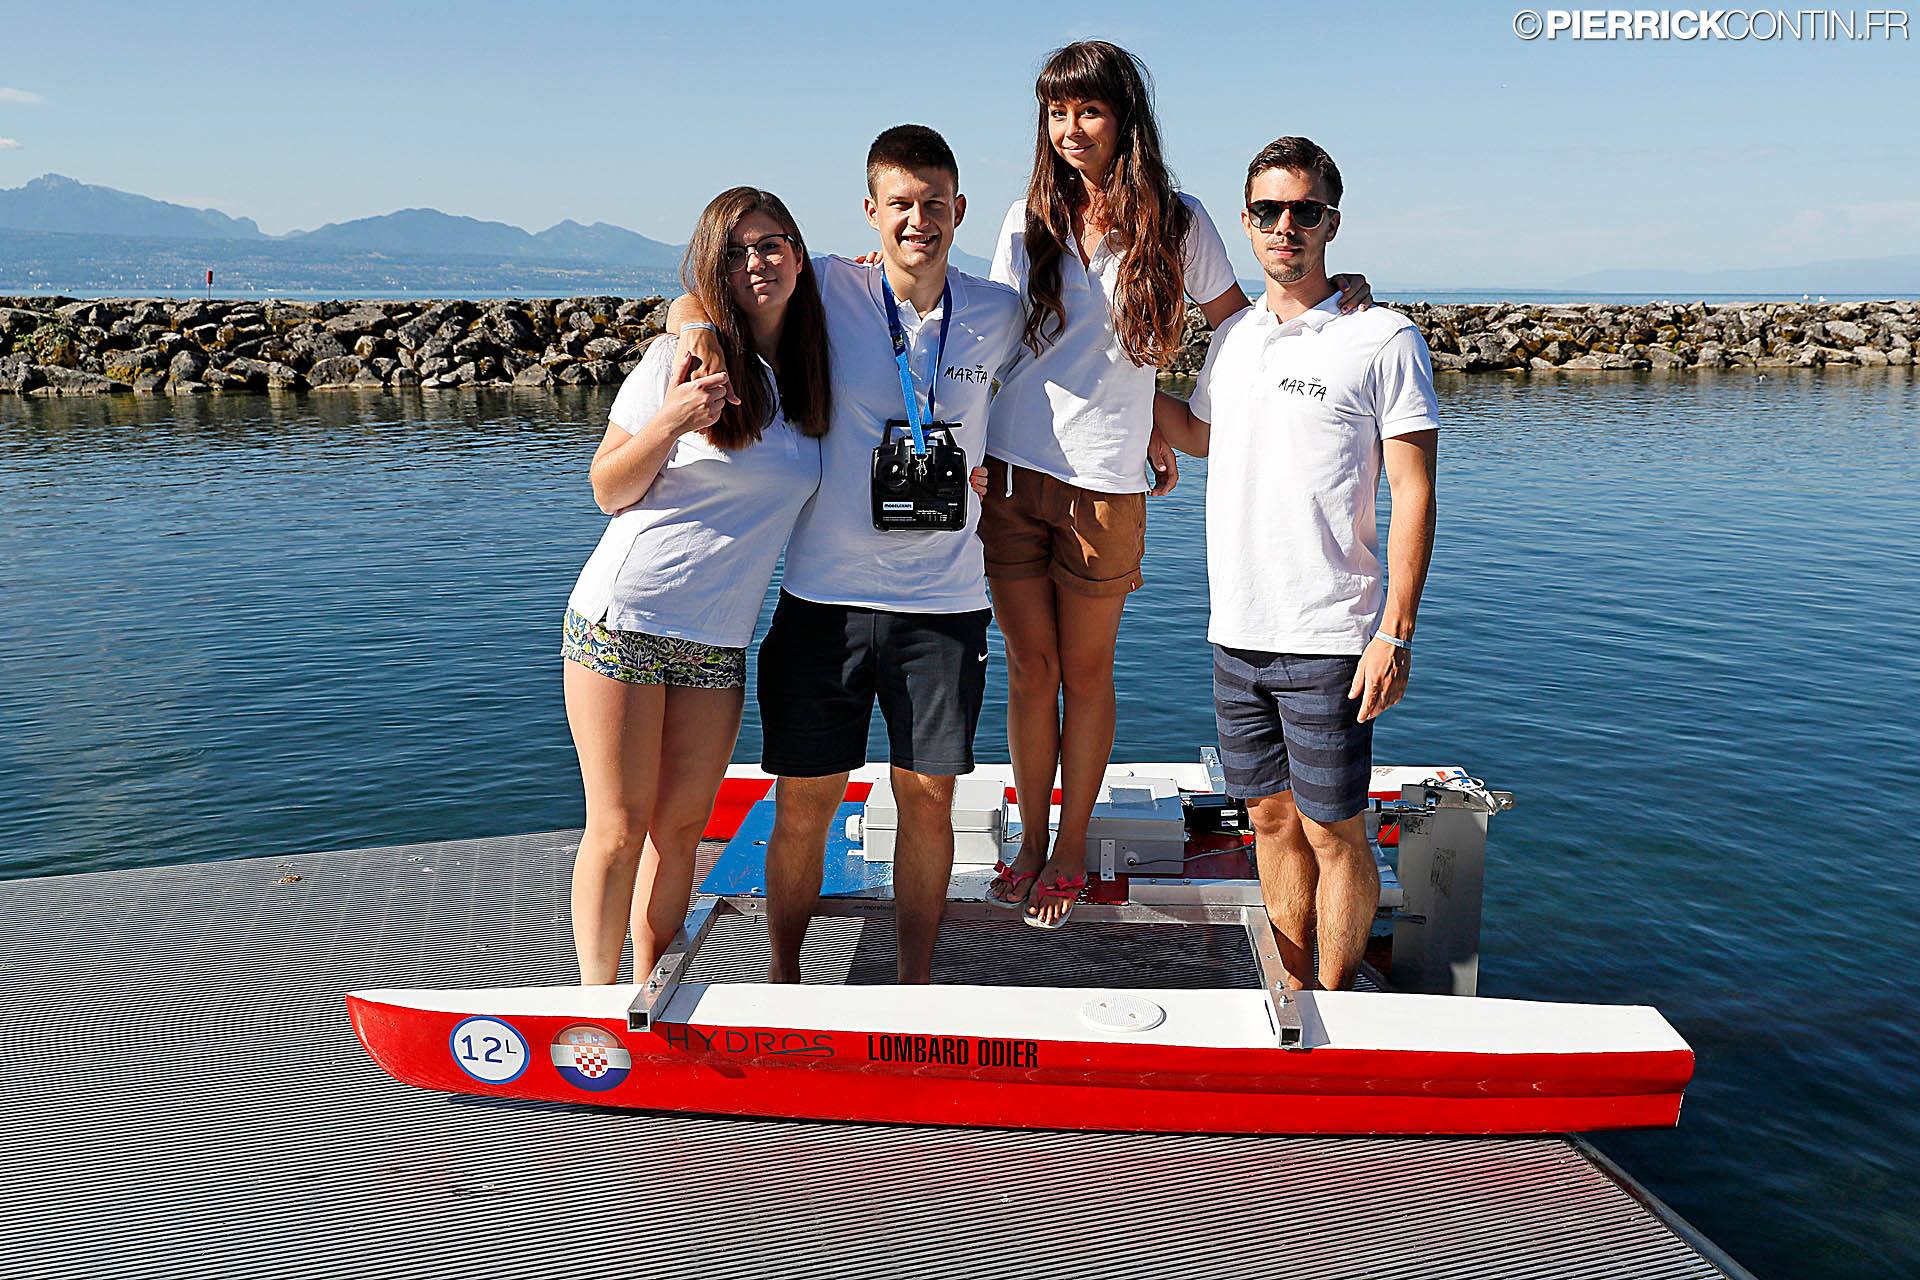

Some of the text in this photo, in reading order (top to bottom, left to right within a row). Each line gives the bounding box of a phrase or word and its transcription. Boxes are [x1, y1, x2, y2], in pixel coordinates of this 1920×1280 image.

[944, 365, 988, 385] MARTA
[1278, 377, 1327, 401] MARTA
[667, 1025, 835, 1057] HYDROS
[867, 1034, 1038, 1068] LOMBARD ODIER
